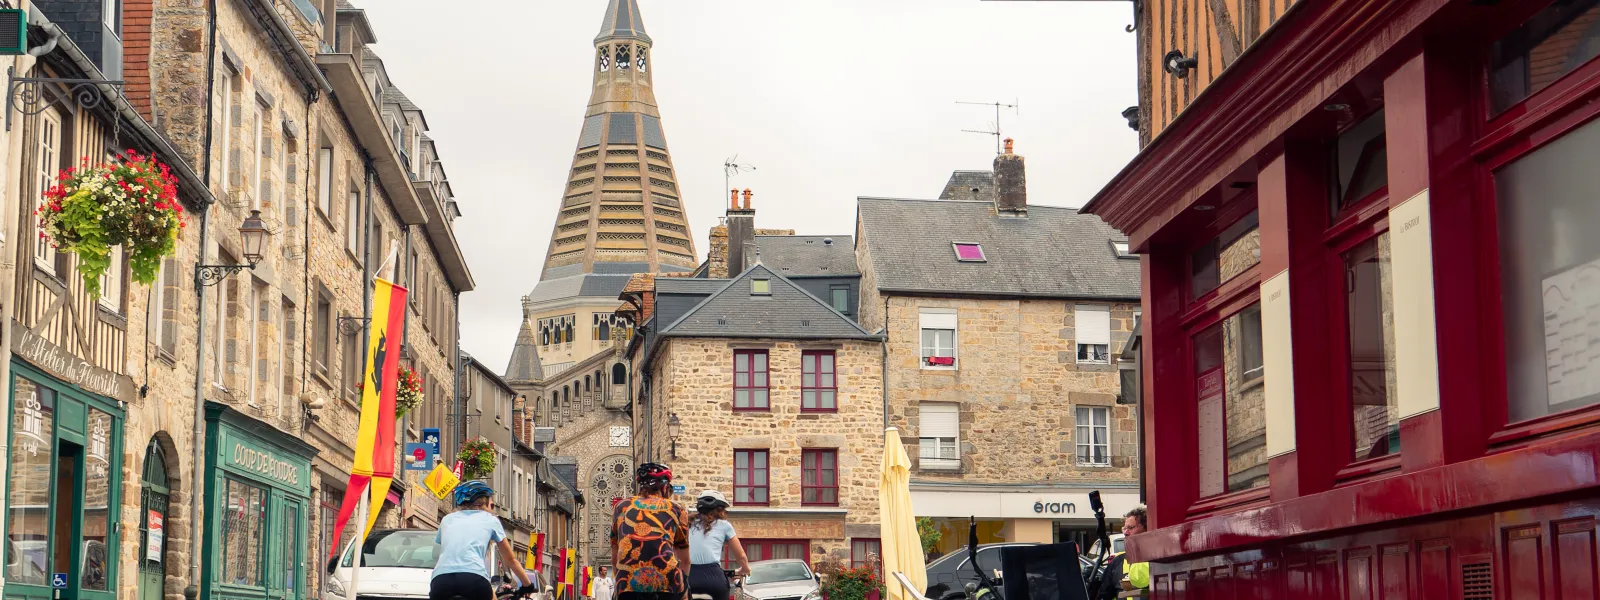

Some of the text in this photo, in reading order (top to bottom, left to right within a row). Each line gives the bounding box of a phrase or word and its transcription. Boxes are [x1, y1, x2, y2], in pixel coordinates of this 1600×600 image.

[66, 358, 77, 382] du
[77, 361, 120, 398] Fleuriste
[234, 443, 298, 485] COUP DE FOUDRE
[437, 477, 457, 498] PRESSE
